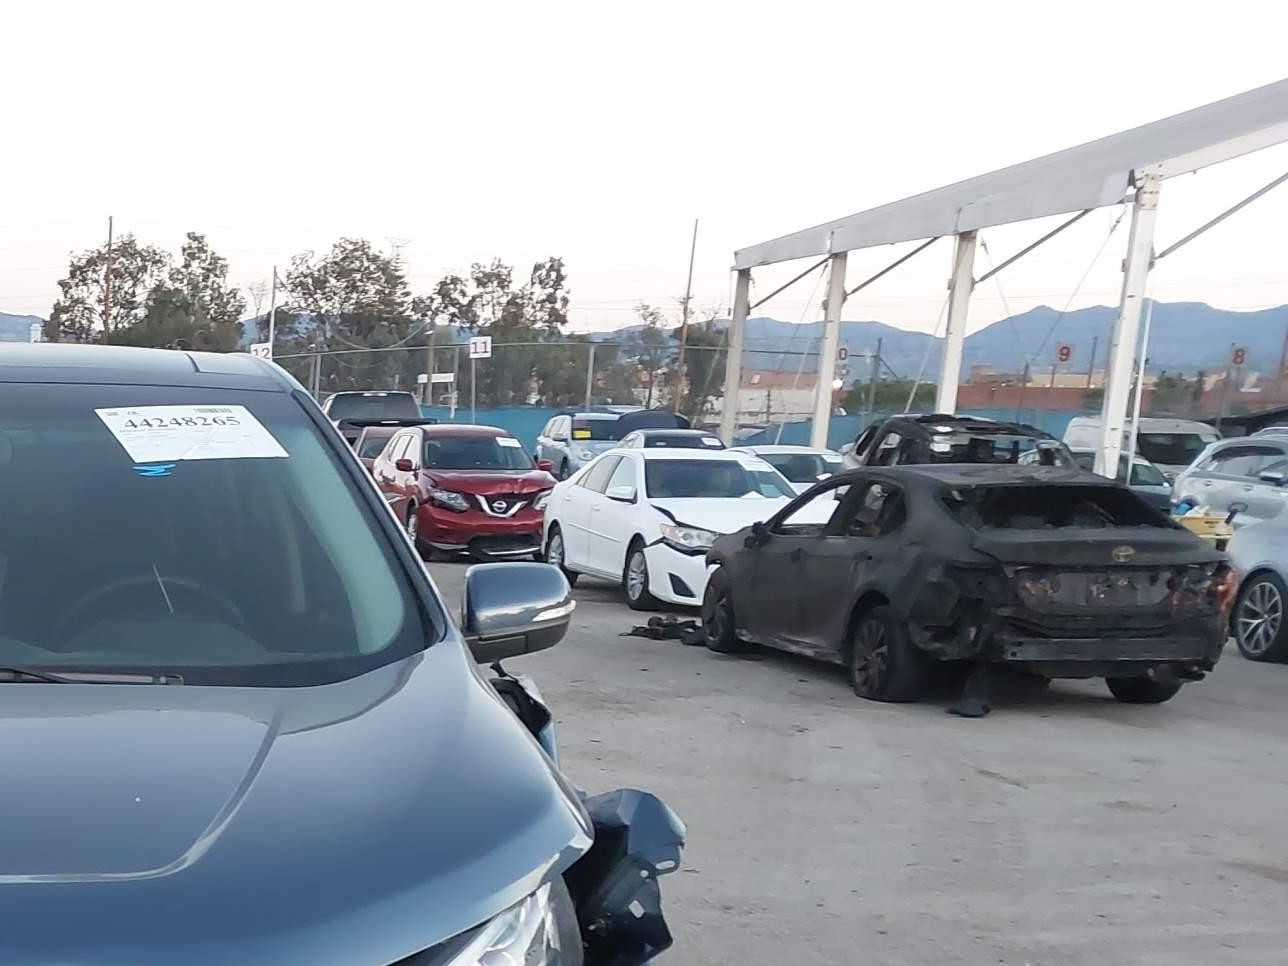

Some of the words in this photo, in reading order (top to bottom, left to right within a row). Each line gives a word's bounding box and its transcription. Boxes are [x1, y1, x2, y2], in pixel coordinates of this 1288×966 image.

[253, 347, 271, 360] 12
[472, 341, 489, 353] 11
[1059, 346, 1070, 362] 9
[124, 411, 241, 429] 44248265
